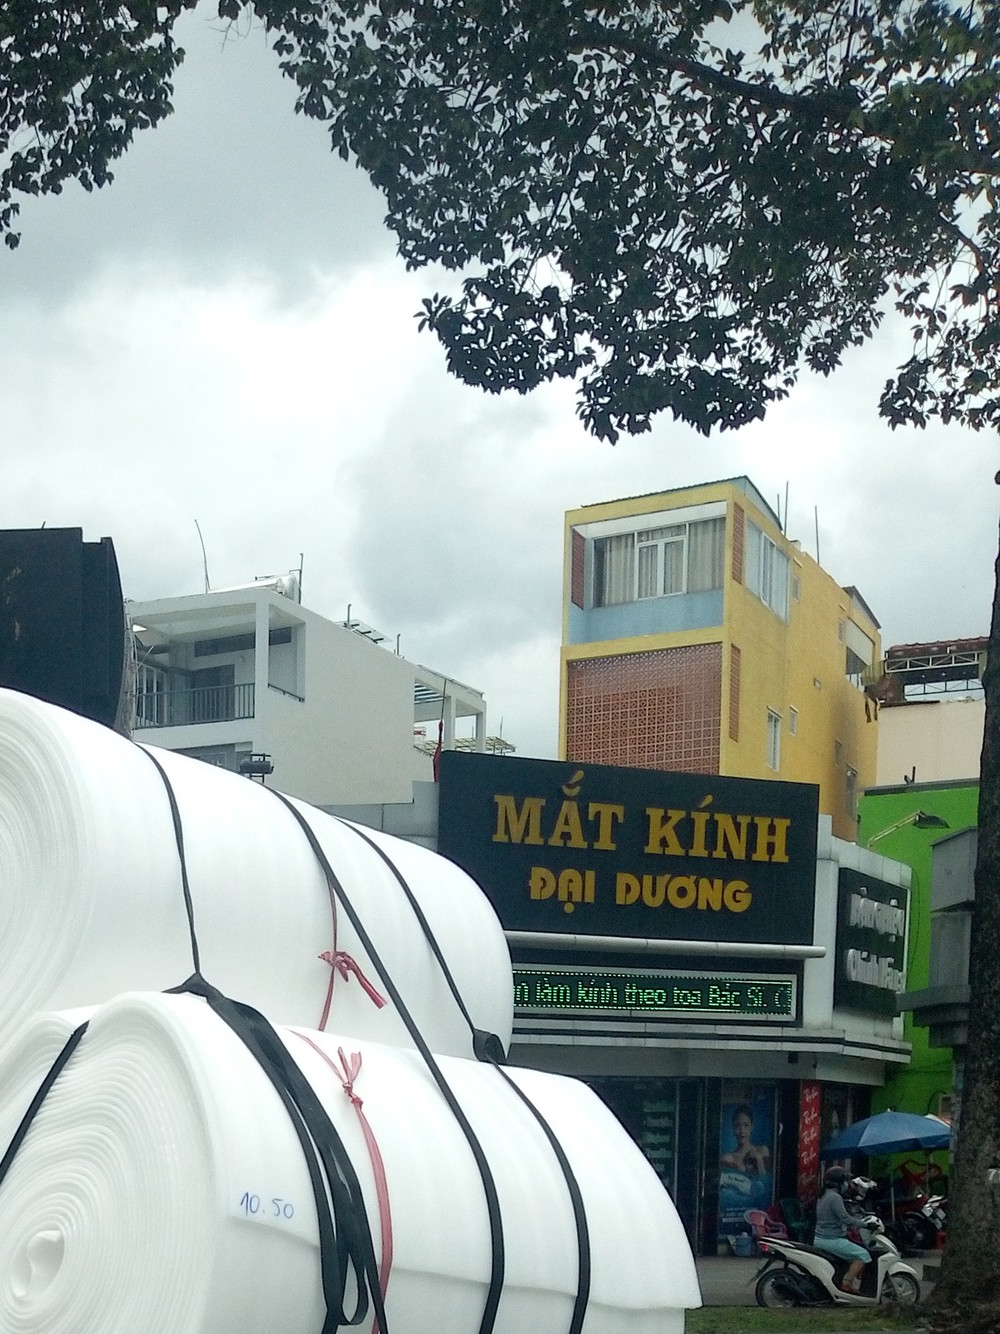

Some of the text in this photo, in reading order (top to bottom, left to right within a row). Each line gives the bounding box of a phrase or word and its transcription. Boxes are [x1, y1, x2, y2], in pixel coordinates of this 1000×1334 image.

[492, 769, 792, 863] MẮT KÍNH
[528, 866, 753, 914] ĐẠI DƯƠNG
[625, 983, 667, 1005] theo
